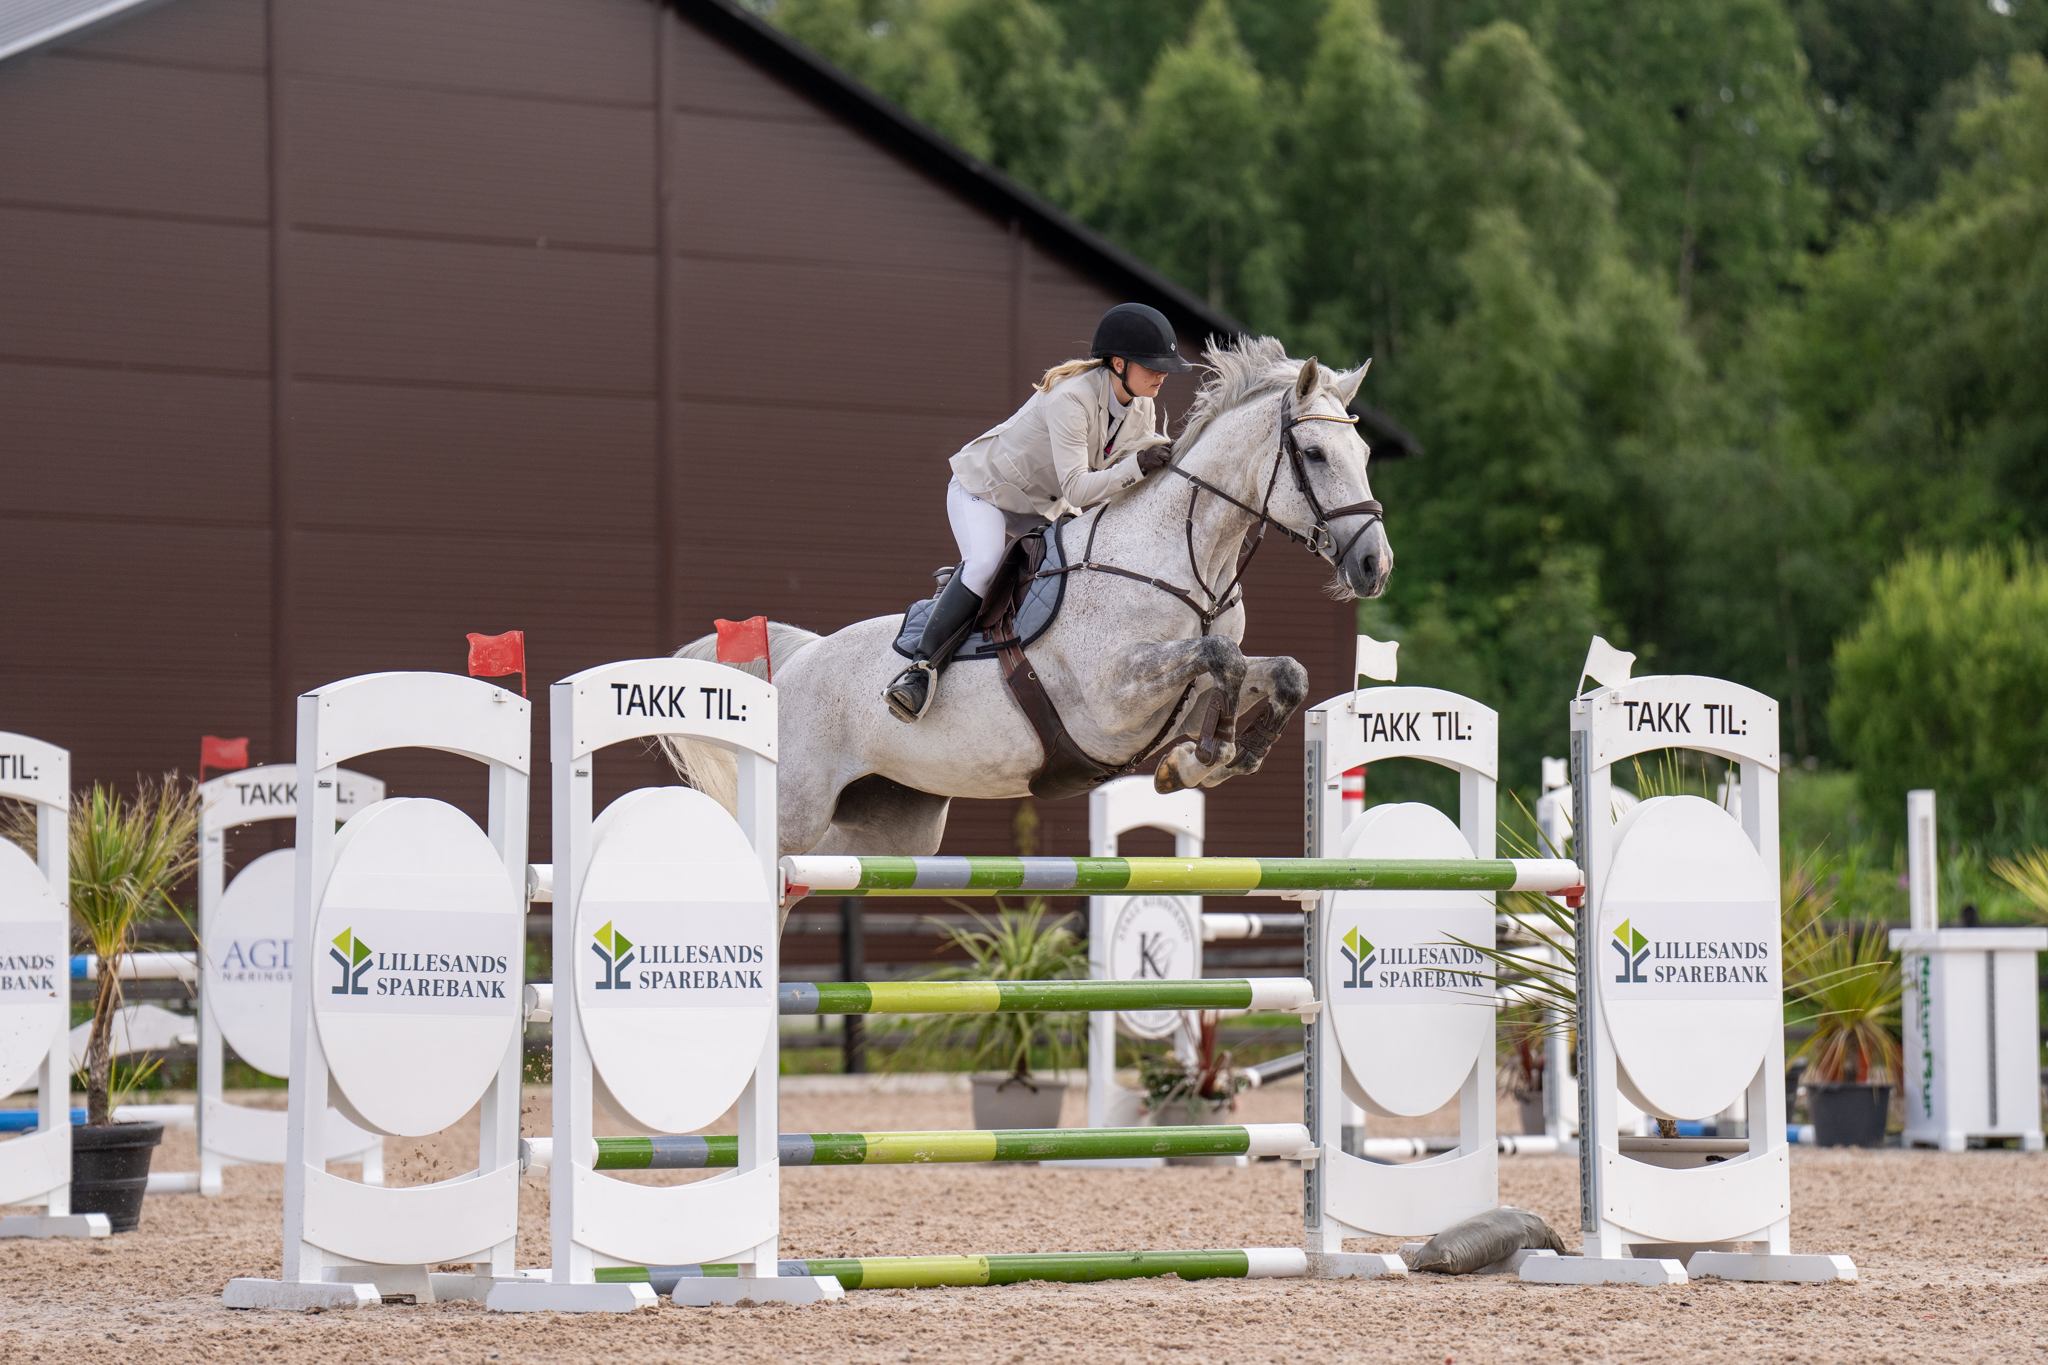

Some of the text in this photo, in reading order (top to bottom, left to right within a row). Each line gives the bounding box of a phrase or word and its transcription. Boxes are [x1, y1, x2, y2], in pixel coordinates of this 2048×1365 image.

[611, 683, 747, 721] TAKK TIL:
[1358, 711, 1472, 742] TAKK TIL:
[1623, 701, 1747, 735] TAKK TIL:
[235, 782, 297, 805] TAKK
[639, 944, 763, 964] LILLESANDS
[1379, 948, 1484, 965] LILLESANDS
[1654, 941, 1768, 960] LILLESANDS
[378, 952, 507, 974] LILLESANDS
[1, 975, 54, 990] BANK
[639, 970, 763, 989] SPAREBANK
[1379, 971, 1484, 988] SPAREBANK
[1654, 965, 1768, 984] SPAREBANK
[376, 977, 506, 998] SPAREBANK
